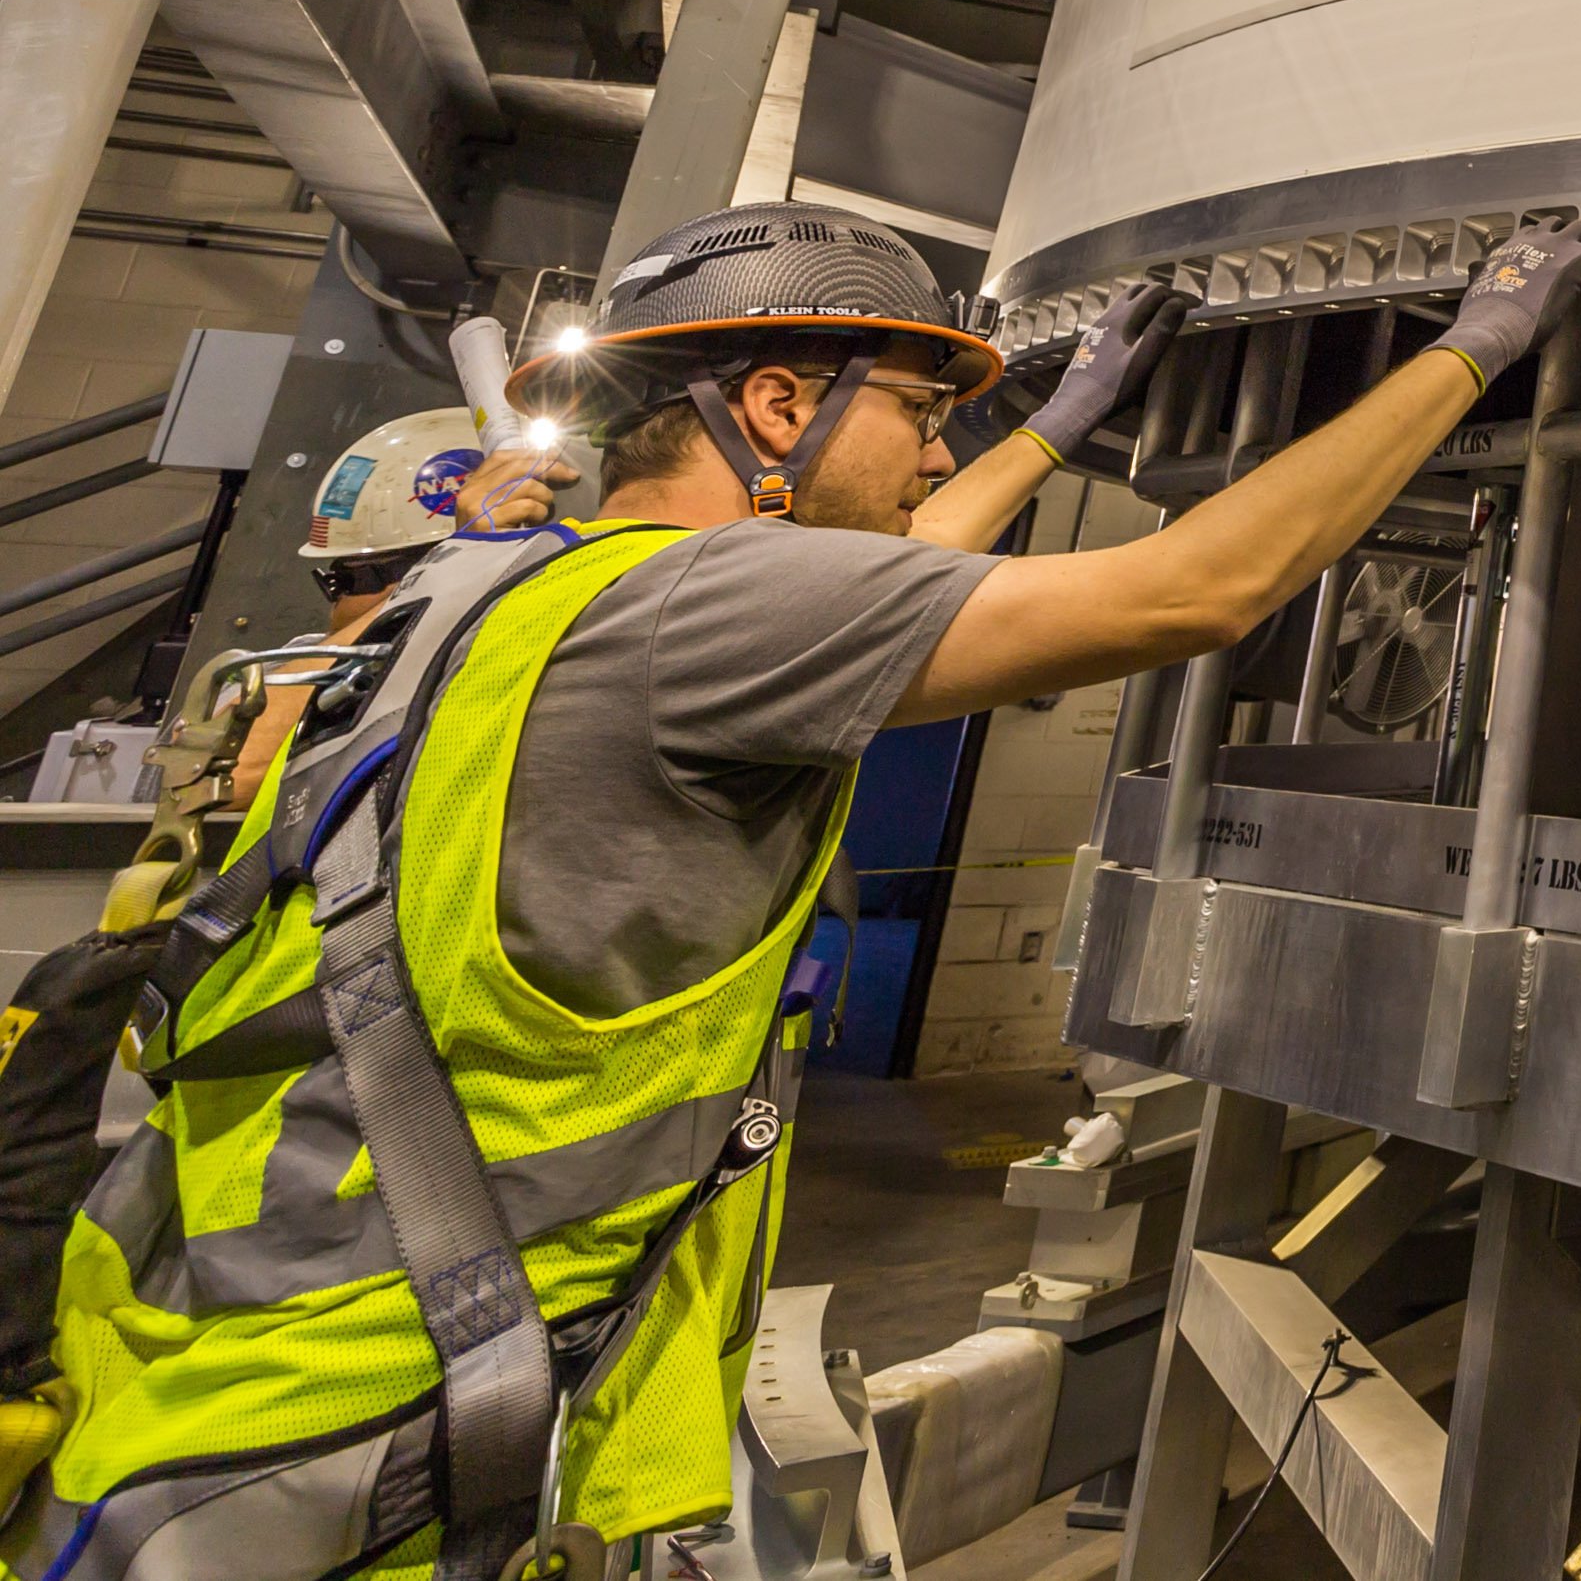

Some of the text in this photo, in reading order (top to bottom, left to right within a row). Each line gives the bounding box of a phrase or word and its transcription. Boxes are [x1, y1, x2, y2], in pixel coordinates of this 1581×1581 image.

[768, 306, 813, 316] KLEIN
[1460, 428, 1496, 455] LBS
[418, 473, 468, 497] NA
